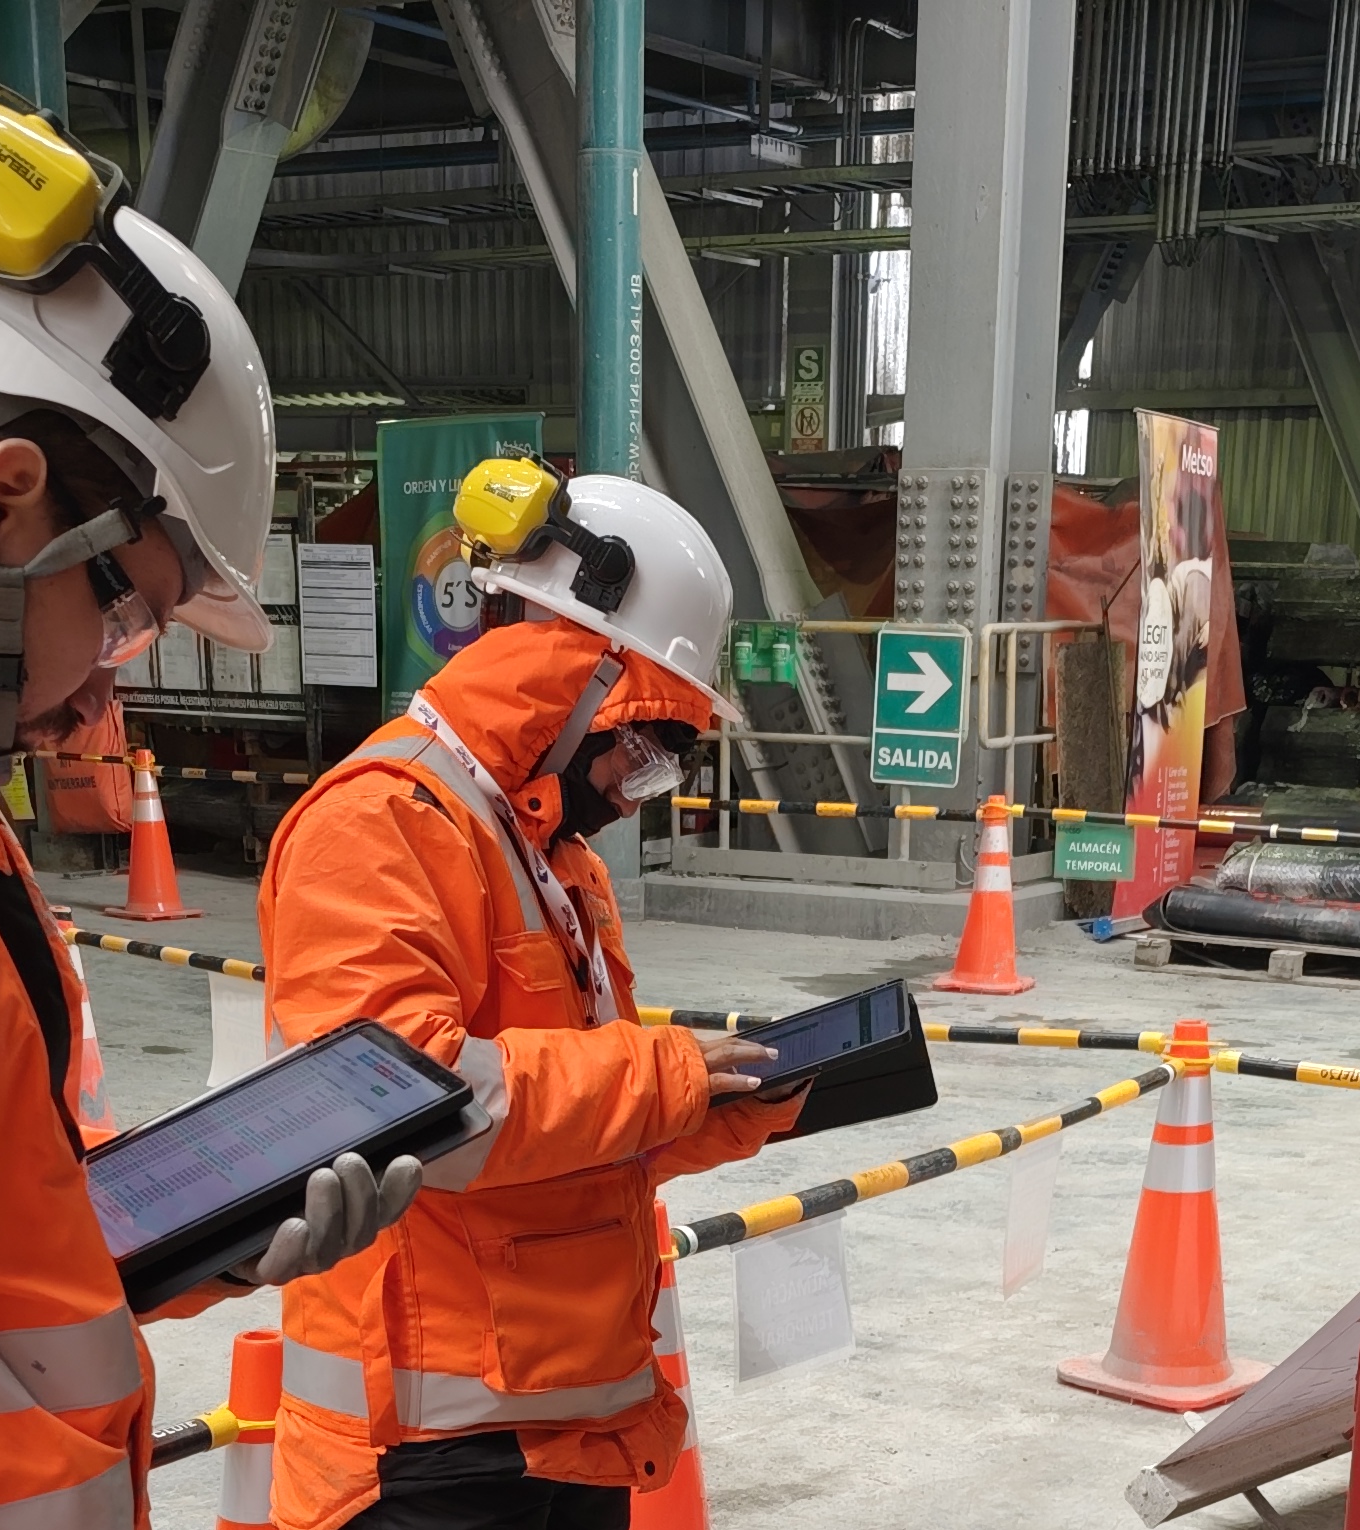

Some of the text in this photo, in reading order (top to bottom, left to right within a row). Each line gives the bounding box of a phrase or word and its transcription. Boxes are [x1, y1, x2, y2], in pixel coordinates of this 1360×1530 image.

[797, 349, 820, 380] S
[1181, 444, 1213, 478] Metso
[403, 480, 436, 495] ORDEN
[439, 479, 447, 493] Y
[1142, 624, 1167, 646] LEGIT
[878, 746, 953, 770] SALIDA
[1068, 841, 1121, 855] ALMACÉN
[1065, 859, 1123, 873] TEMPORAL
